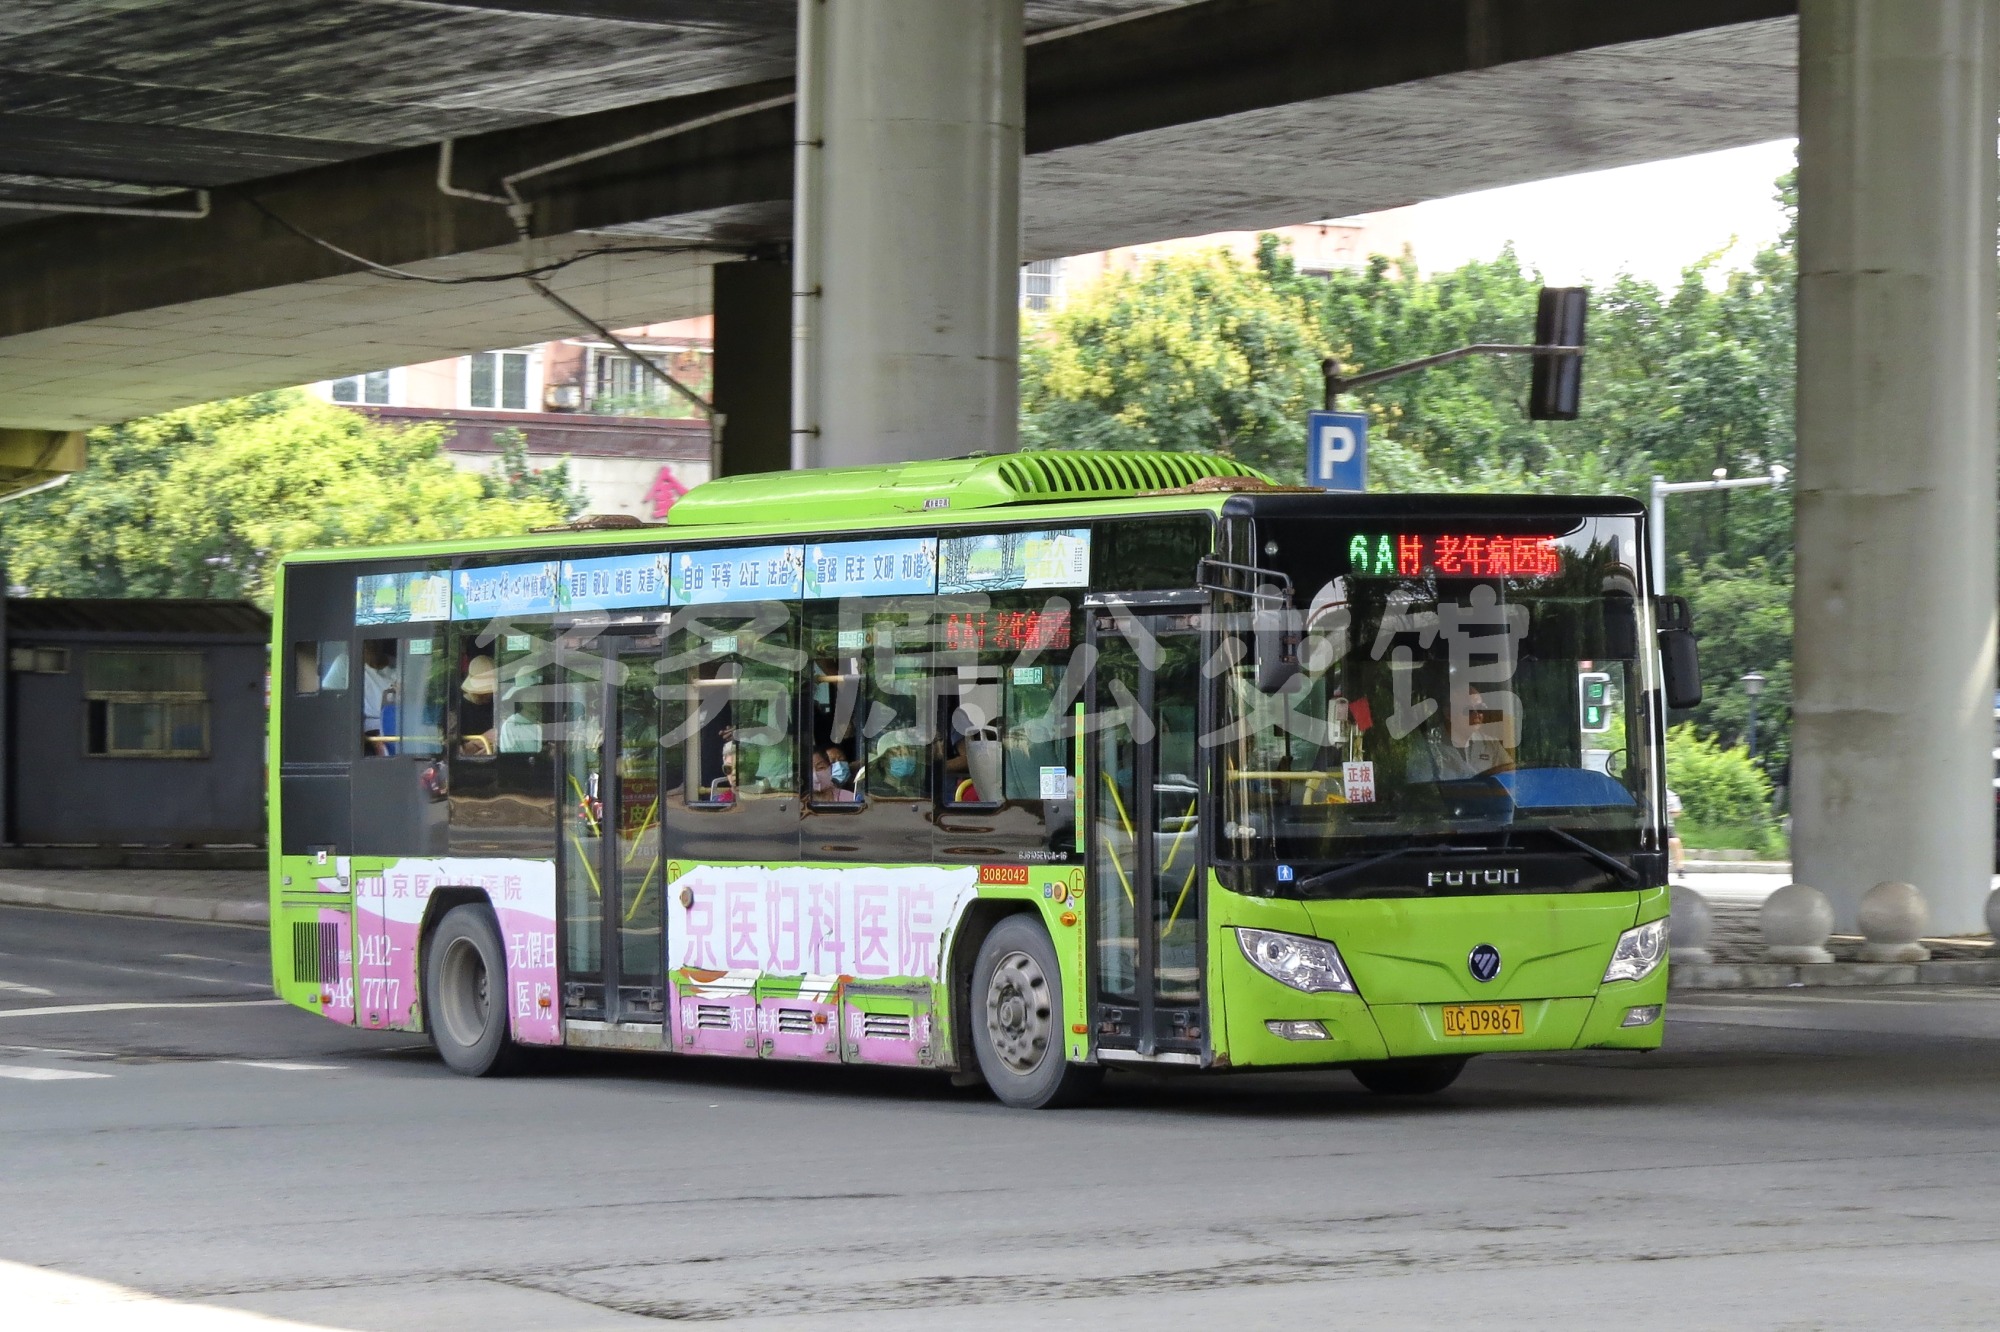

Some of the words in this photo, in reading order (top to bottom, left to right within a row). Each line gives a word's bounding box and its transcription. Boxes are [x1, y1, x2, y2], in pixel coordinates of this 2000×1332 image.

[1319, 426, 1356, 479] P
[816, 557, 838, 585] 富强
[844, 555, 866, 582] 民主
[873, 554, 894, 580] 文明
[902, 553, 924, 579] 和谐
[1434, 535, 1558, 574] 老年病医院
[570, 573, 588, 598] 爱国
[593, 570, 610, 597] 敬业
[615, 569, 633, 595] 诚信
[637, 568, 655, 593] 友善
[683, 565, 704, 591] 自由
[711, 563, 732, 589] 平等
[739, 561, 760, 587] 公正
[767, 560, 789, 586] 法治
[983, 868, 1026, 881] 3082042
[1427, 869, 1519, 887] FOTON
[682, 878, 938, 977] 京医妇科医院
[509, 932, 556, 969] 无假日
[363, 979, 399, 1010] 7777
[516, 981, 552, 1020] 医院
